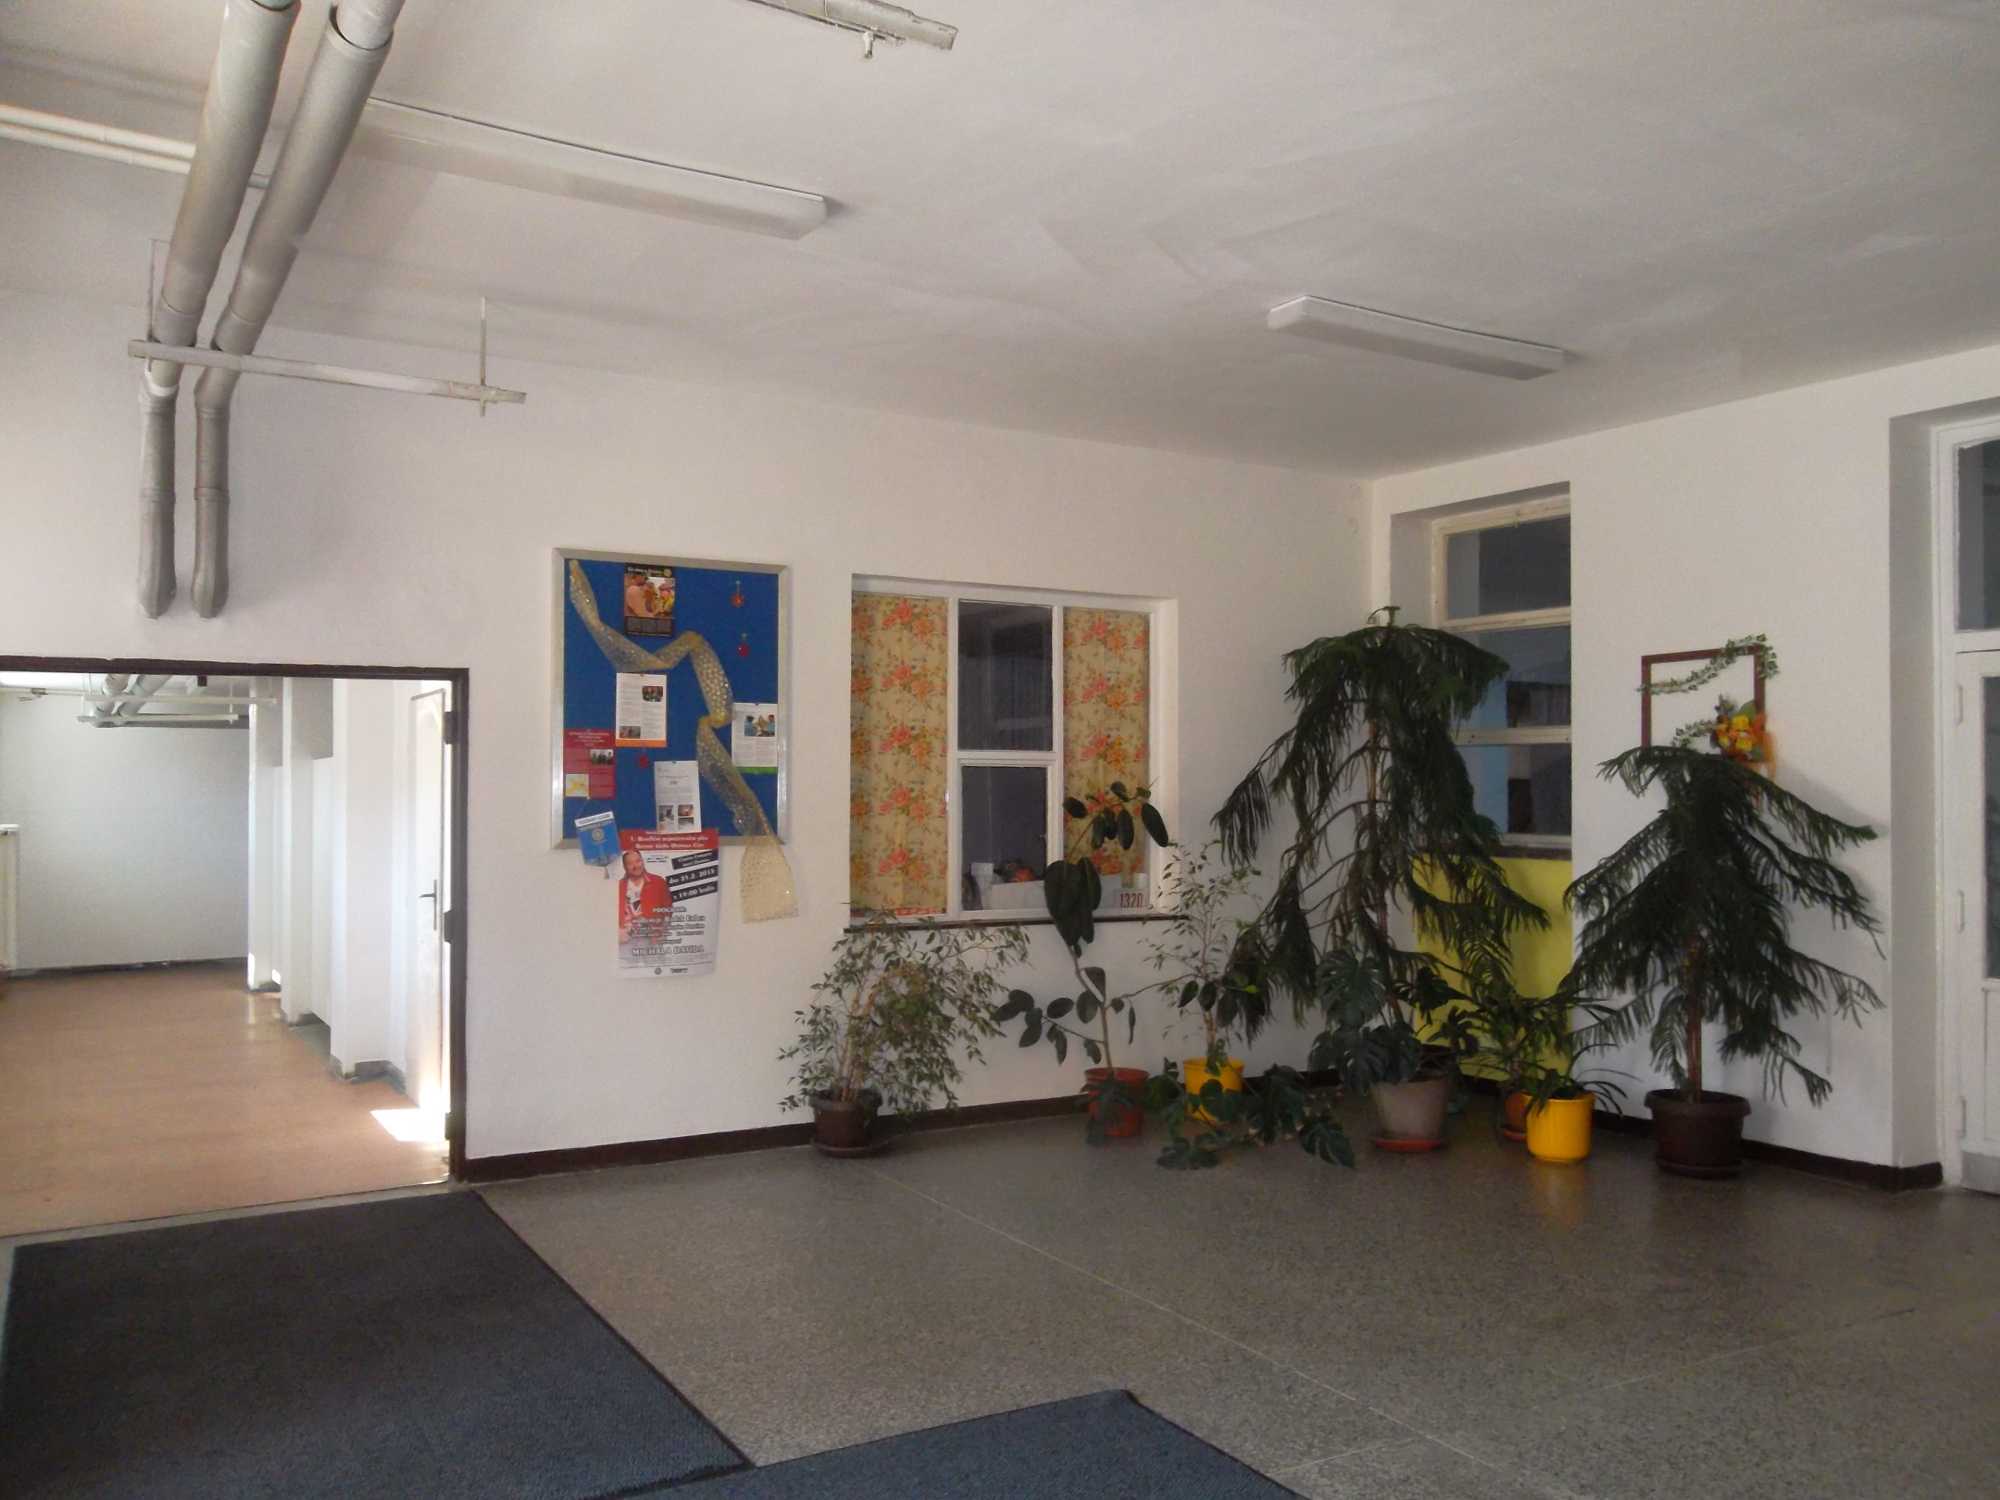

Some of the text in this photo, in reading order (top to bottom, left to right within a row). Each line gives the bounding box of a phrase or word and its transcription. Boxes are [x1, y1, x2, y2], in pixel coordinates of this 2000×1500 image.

[698, 868, 715, 877] 2015
[1119, 892, 1143, 908] 1320
[673, 945, 704, 954] DAVIDA
